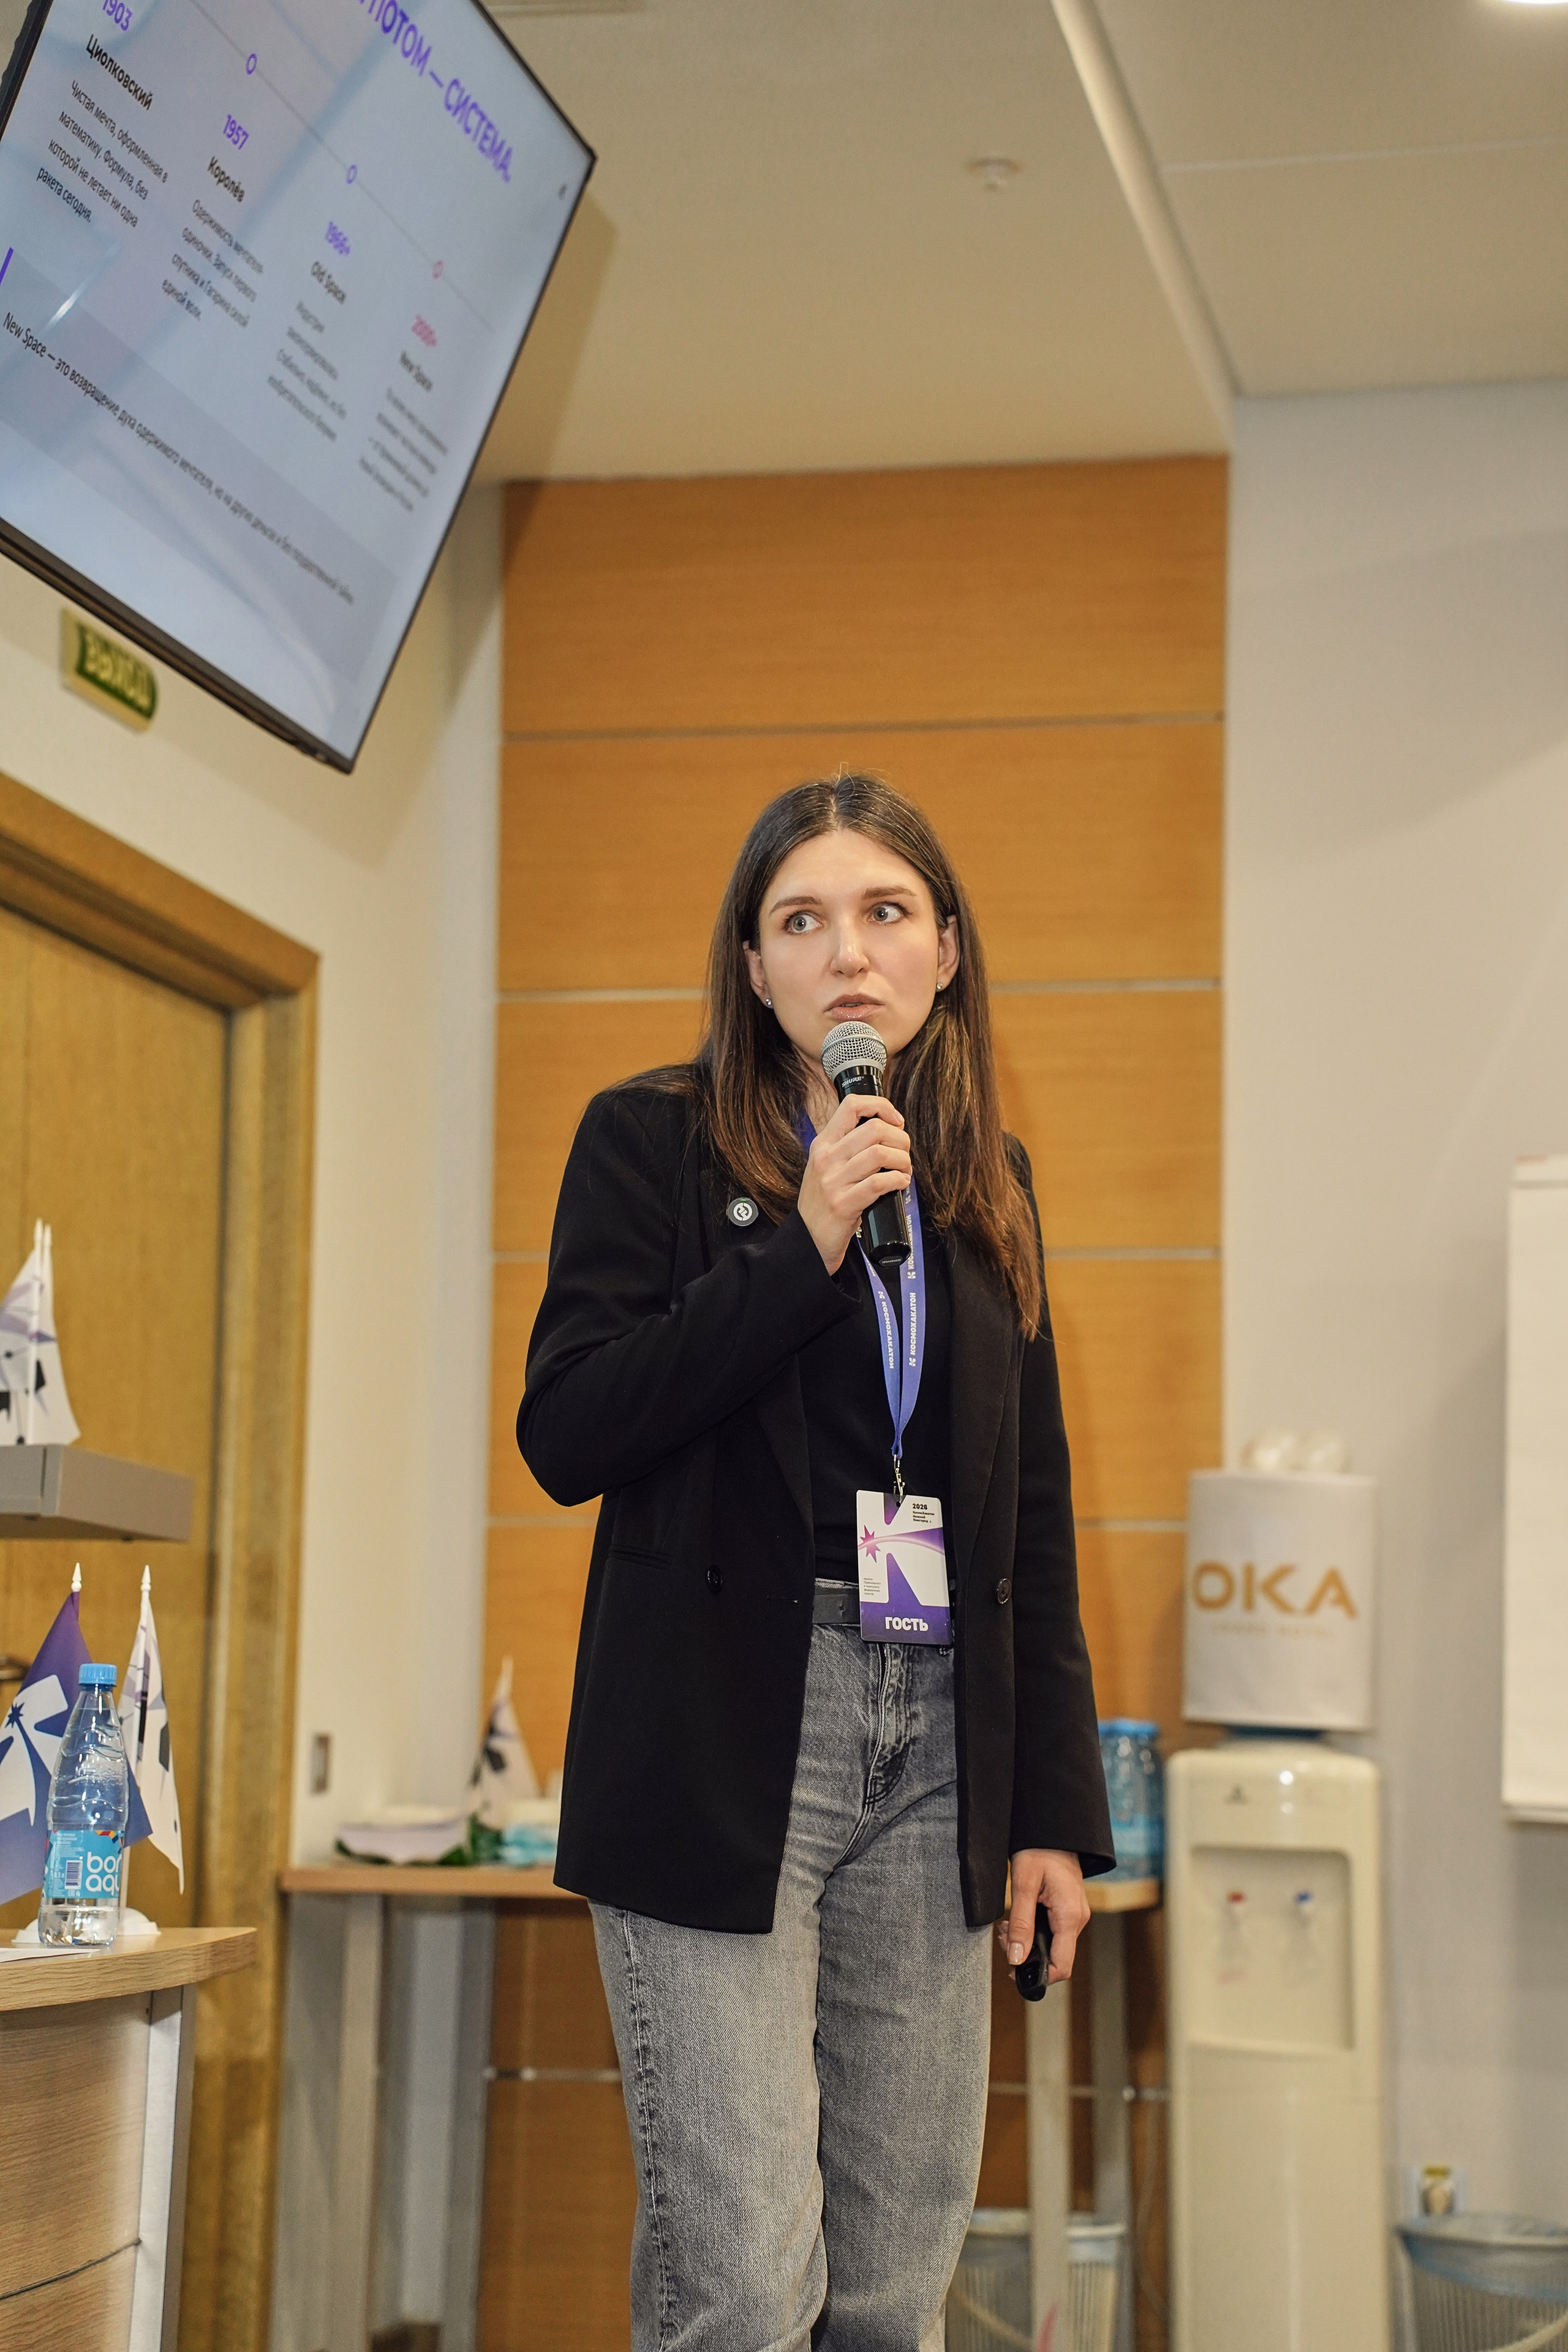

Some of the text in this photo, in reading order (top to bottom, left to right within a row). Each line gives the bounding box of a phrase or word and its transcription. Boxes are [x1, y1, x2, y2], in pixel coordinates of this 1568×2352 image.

[86, 34, 154, 111] Циолковский
[59, 111, 149, 200] математику. Формула, без
[72, 80, 96, 113] Чистая
[94, 107, 116, 137] мечта,
[117, 129, 164, 179] оформленная
[222, 114, 250, 150] 1957
[36, 167, 92, 223] ракета сегодня.
[48, 139, 139, 228] которой не летает ни одна
[207, 156, 245, 203] Королёв
[2, 311, 24, 338] New
[22, 328, 47, 358] Space
[55, 358, 70, 377] это
[69, 369, 120, 417] возвращение
[842, 1076, 862, 1088] SHURE
[881, 1301, 894, 1369] КОСМОХАКАТОН
[1194, 1560, 1357, 1620] OKA
[885, 1616, 929, 1632] ГОСТЬ
